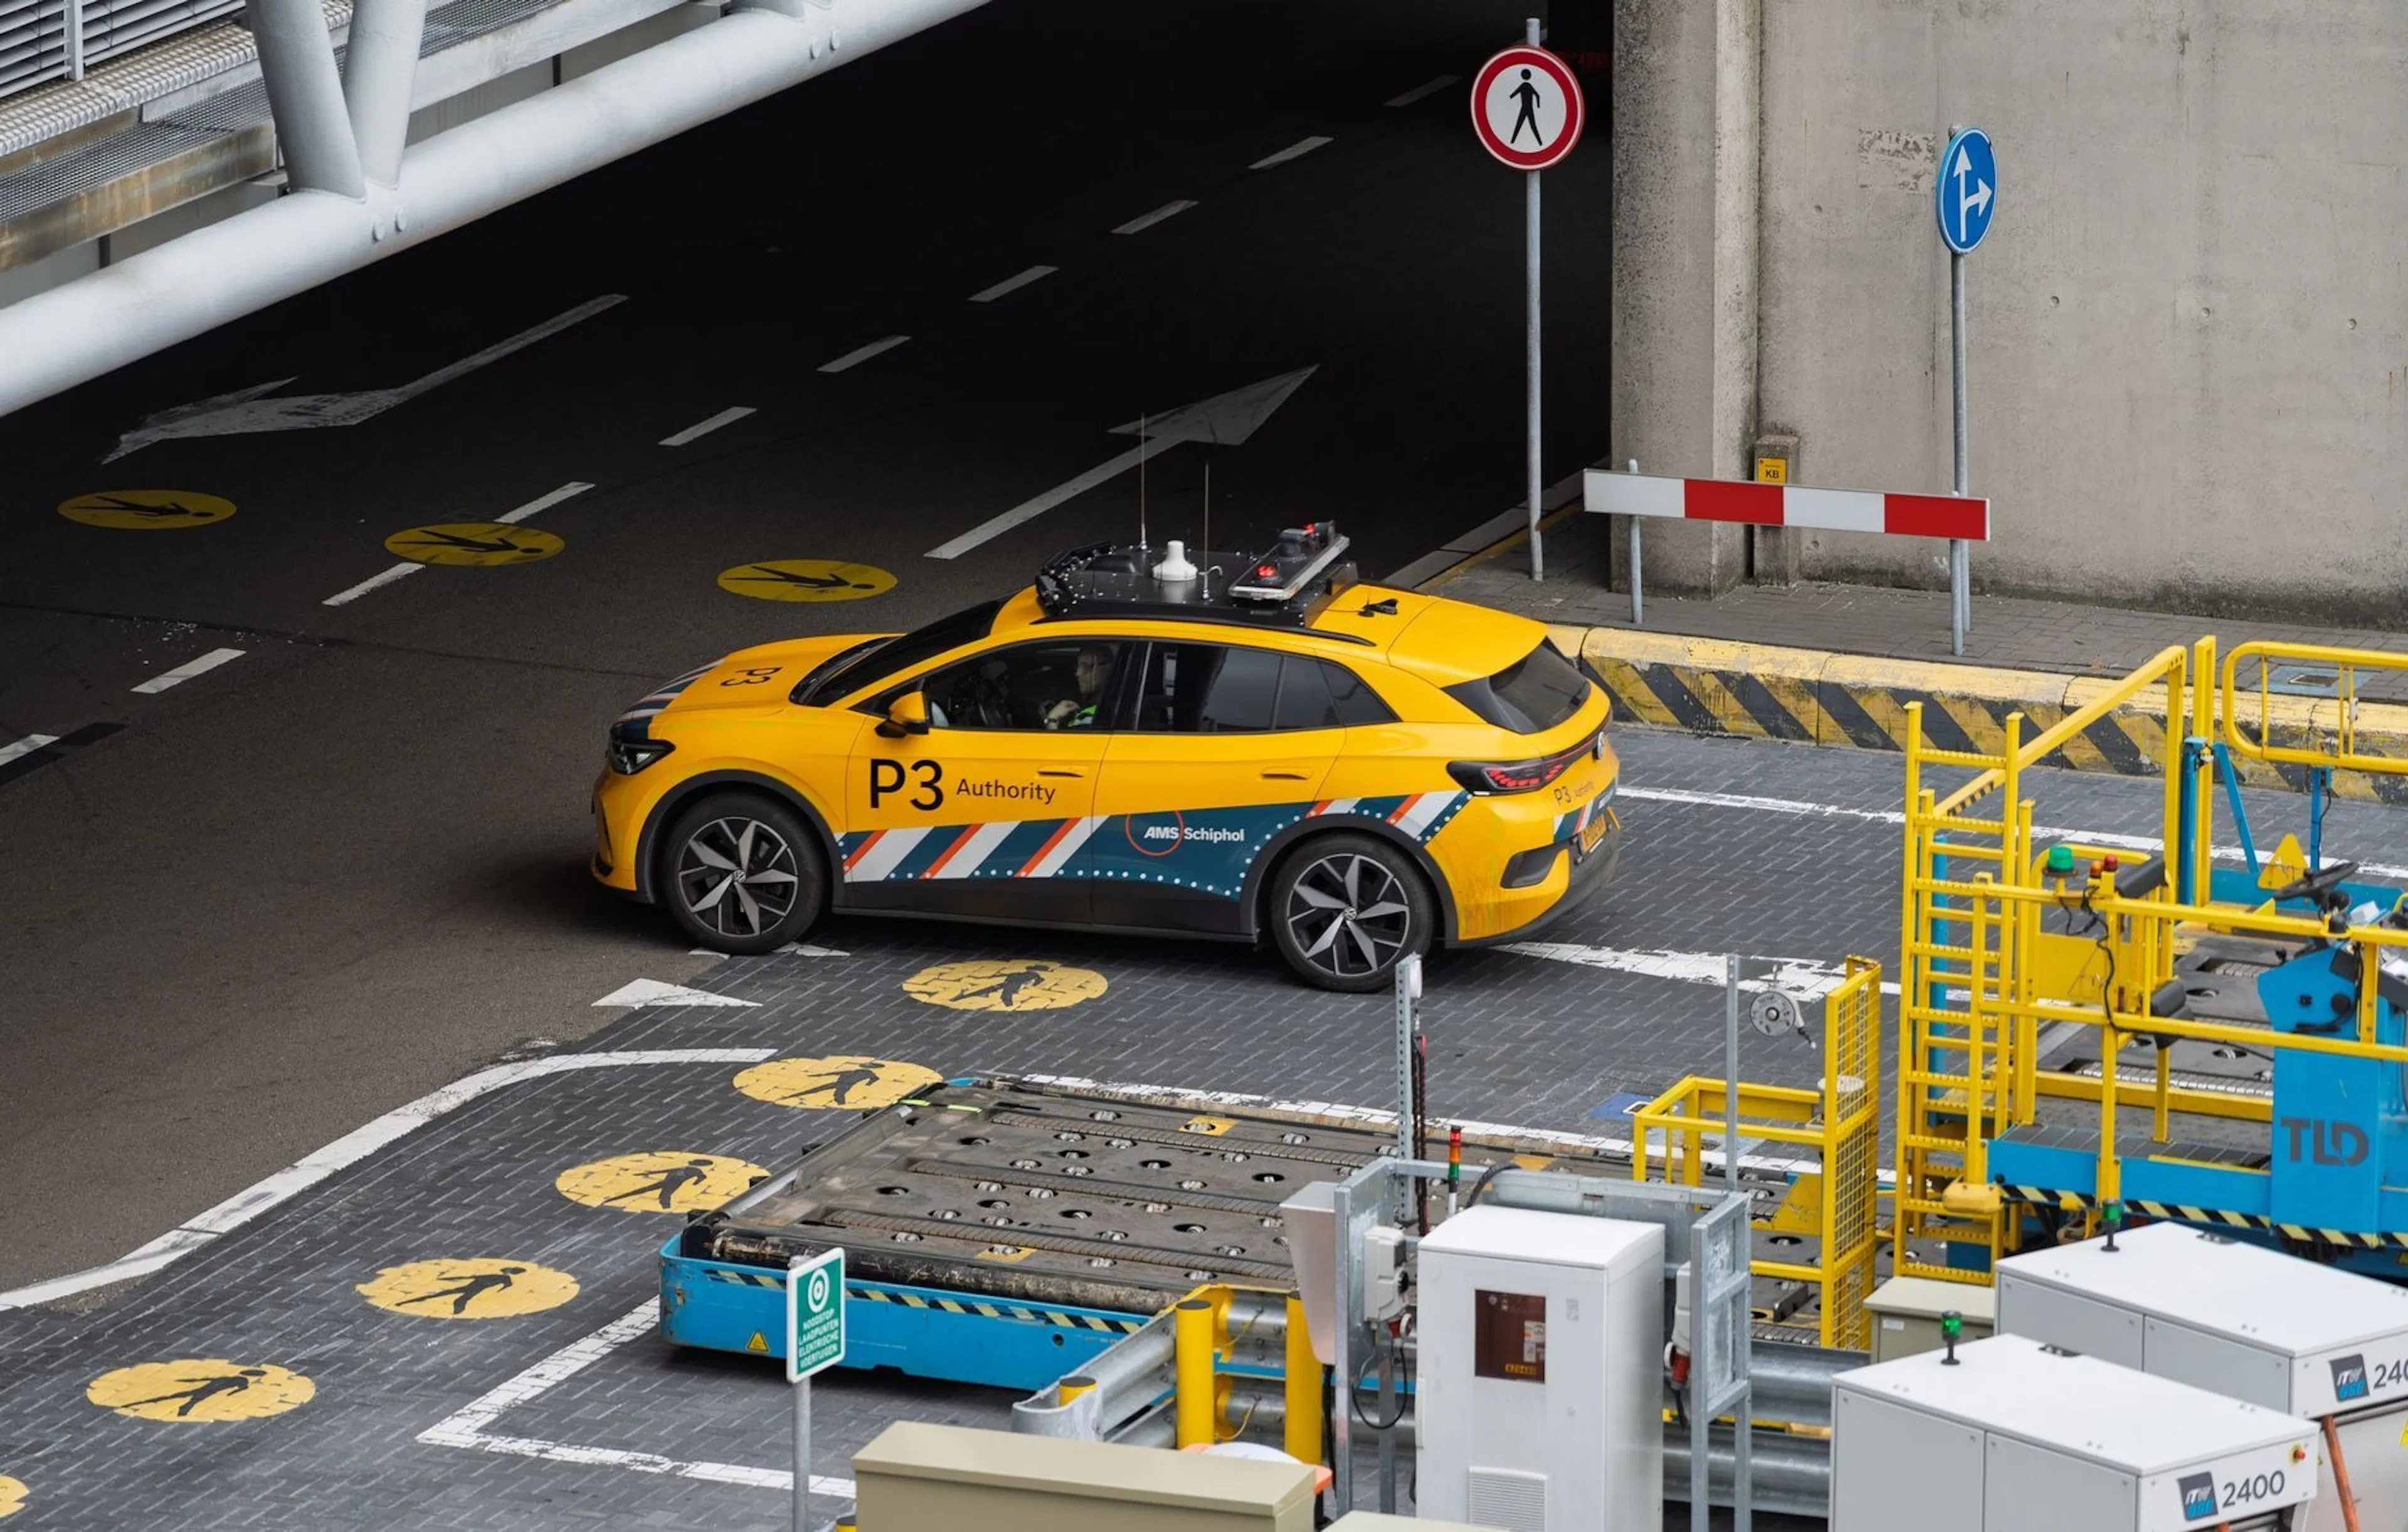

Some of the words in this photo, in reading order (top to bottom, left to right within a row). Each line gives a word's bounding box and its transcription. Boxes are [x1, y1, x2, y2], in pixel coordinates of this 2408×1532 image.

[1765, 469, 1780, 479] KB
[720, 667, 783, 687] P3
[870, 758, 944, 811] P3
[956, 778, 1056, 805] Authority
[1553, 785, 1571, 806] P3
[1143, 826, 1180, 840] AMS
[1183, 827, 1245, 844] Schiphol
[2280, 1116, 2370, 1168] TLD
[798, 1318, 839, 1346] LAADPUNTEN
[2222, 1470, 2284, 1509] 2400
